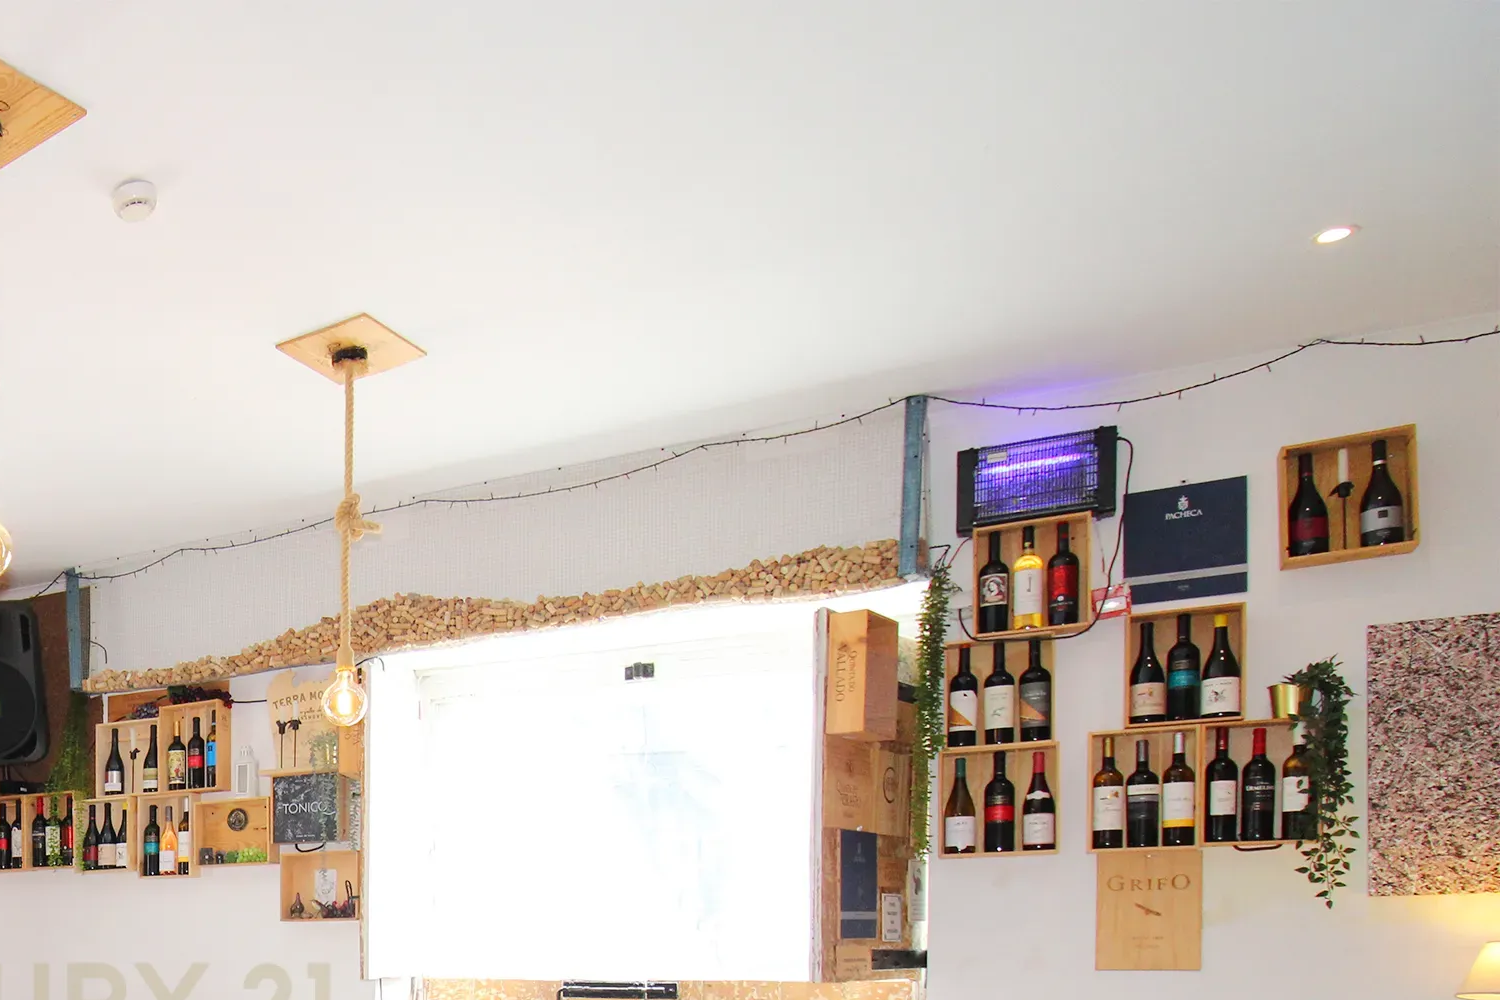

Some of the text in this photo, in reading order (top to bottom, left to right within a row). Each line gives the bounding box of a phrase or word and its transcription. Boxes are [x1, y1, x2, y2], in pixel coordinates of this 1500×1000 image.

[1164, 509, 1203, 520] PACHECA
[835, 642, 848, 702] VALLADO
[1106, 873, 1191, 892] GRIFO
